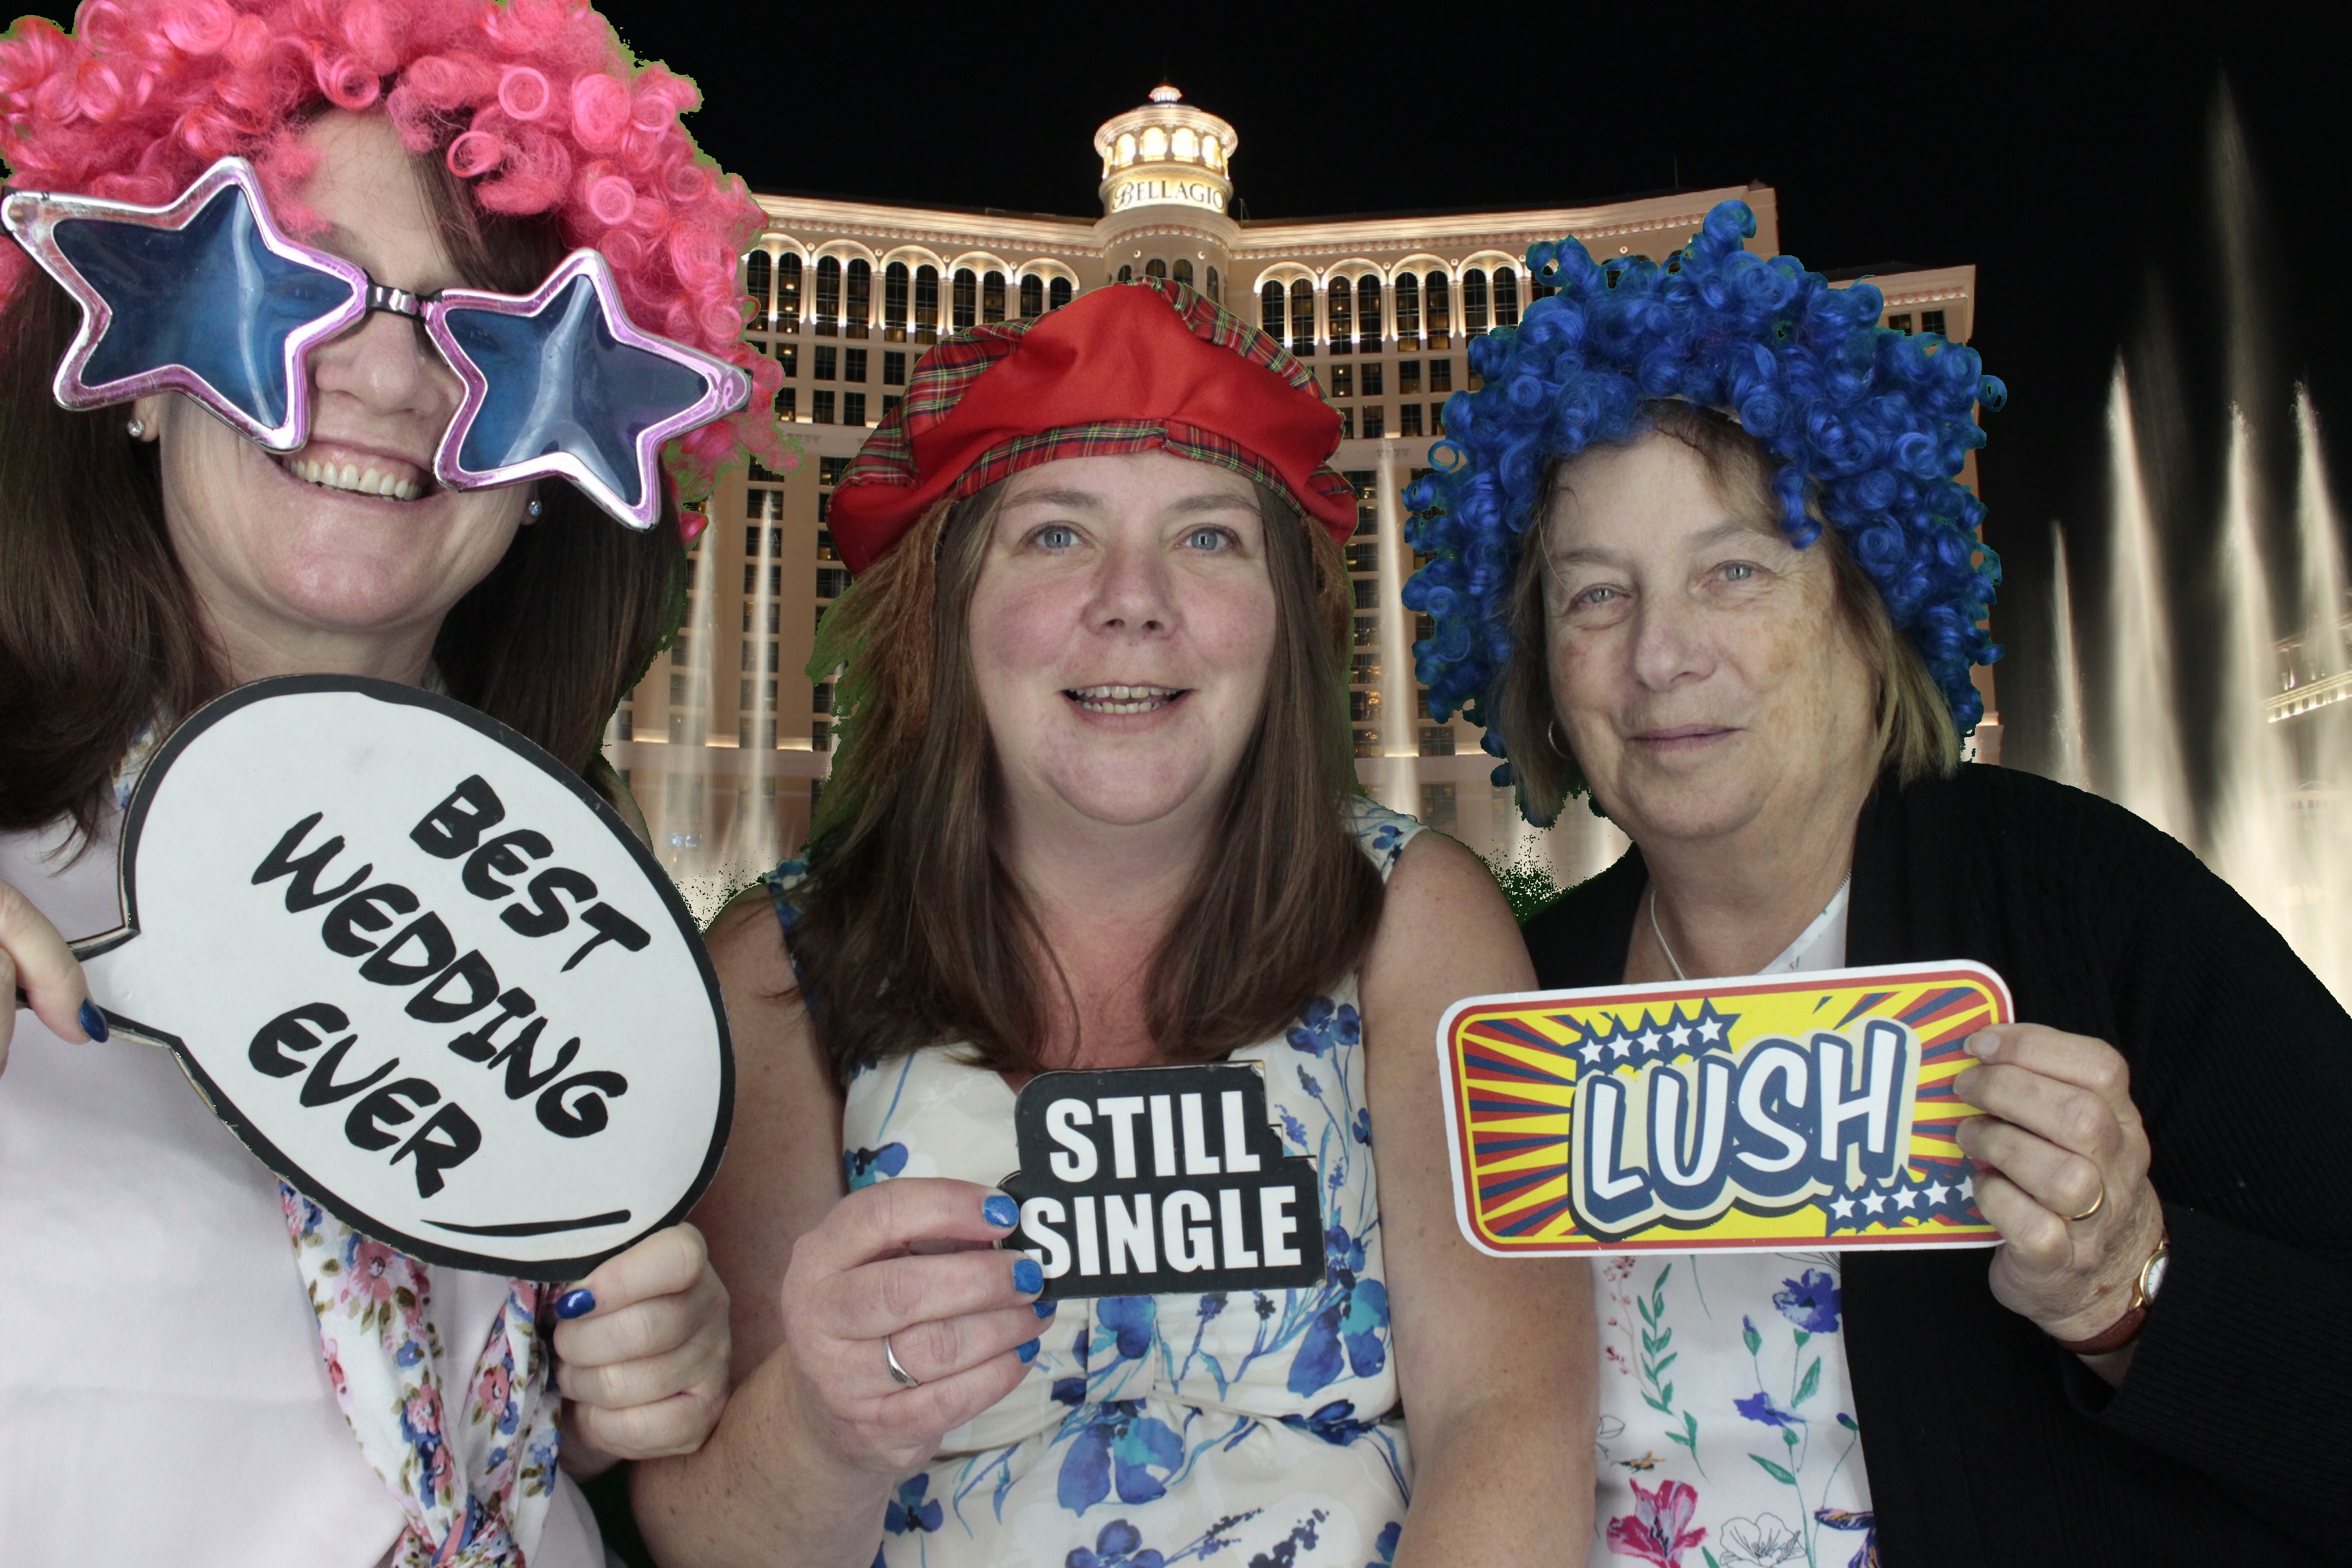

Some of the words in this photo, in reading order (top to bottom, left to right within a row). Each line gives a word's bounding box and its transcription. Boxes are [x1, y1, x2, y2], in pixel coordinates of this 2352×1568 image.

[1111, 180, 1225, 210] BELLAGIO
[410, 774, 651, 973] BEST
[251, 811, 628, 1139] WEDDING
[248, 1002, 482, 1198] EVER
[1045, 1090, 1260, 1183] STILL
[1583, 1019, 1906, 1218] LUSH
[1020, 1186, 1301, 1279] SINGLE
